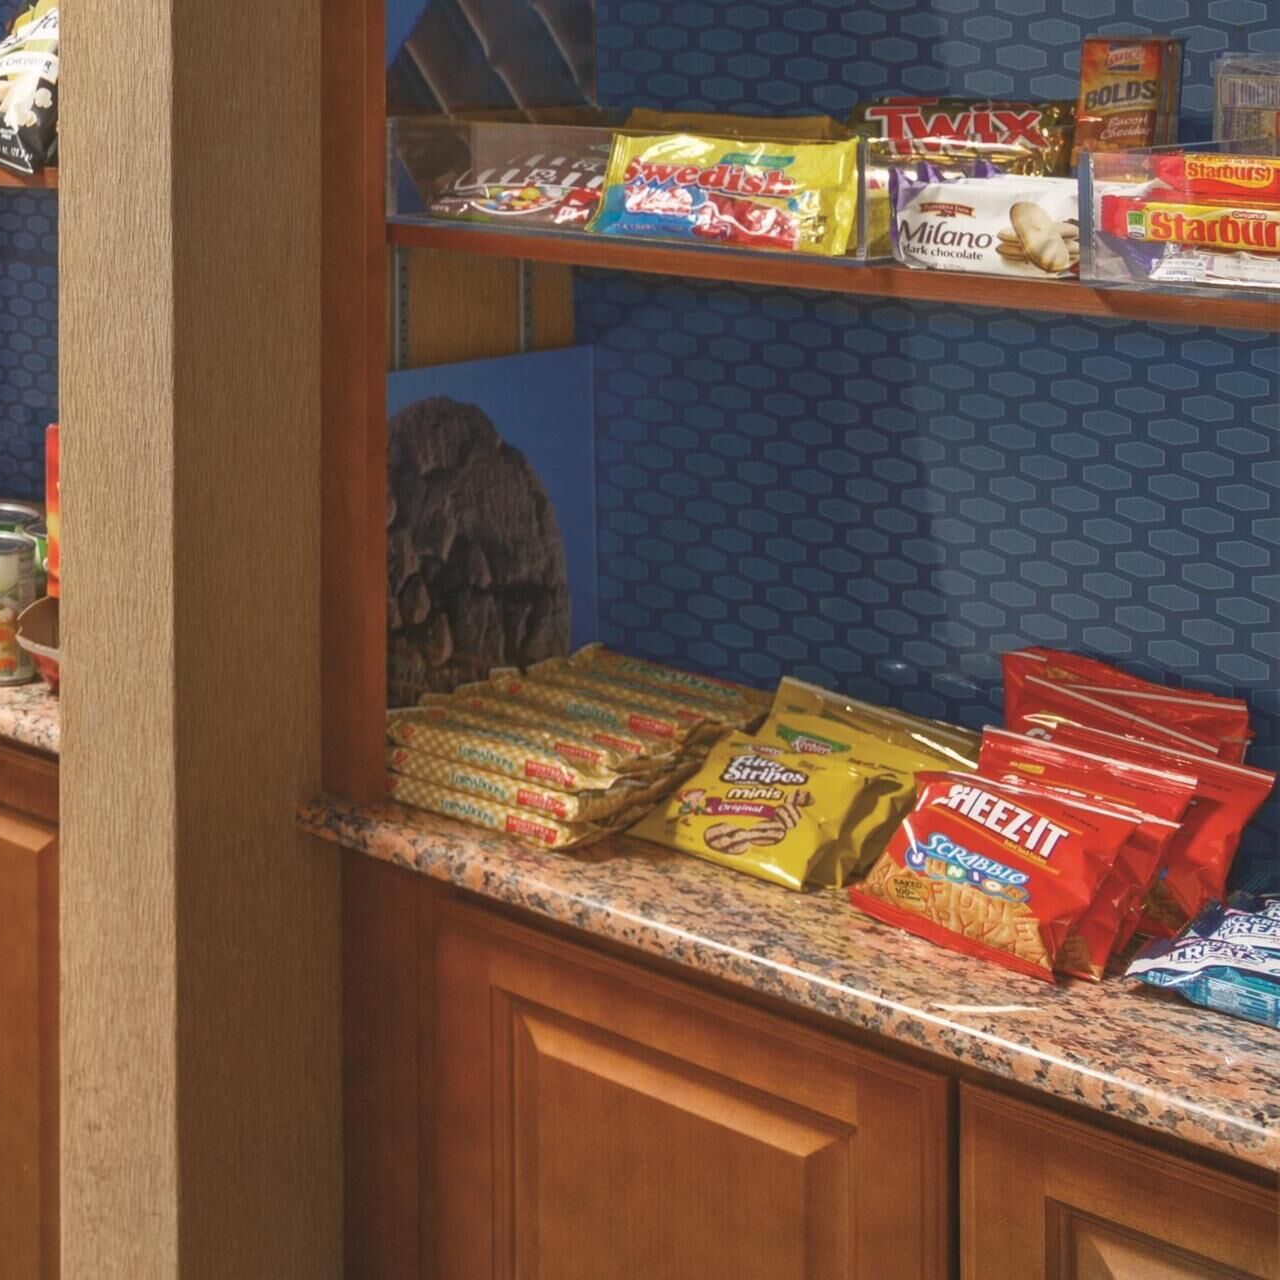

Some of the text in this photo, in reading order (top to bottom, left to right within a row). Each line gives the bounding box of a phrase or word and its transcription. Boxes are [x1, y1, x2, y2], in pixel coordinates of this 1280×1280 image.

[1085, 79, 1157, 111] BOLDS
[624, 156, 797, 197] Swedish
[1187, 162, 1272, 182] Starburst
[899, 220, 993, 249] Milano
[1150, 211, 1280, 248] Starbur
[903, 242, 984, 261] dark chocolate
[723, 767, 807, 785] Stripes
[727, 787, 783, 801] minis
[718, 803, 765, 814] Original
[893, 878, 923, 889] BAKED
[1219, 921, 1280, 939] TREA
[1169, 945, 1266, 963] TREATS
